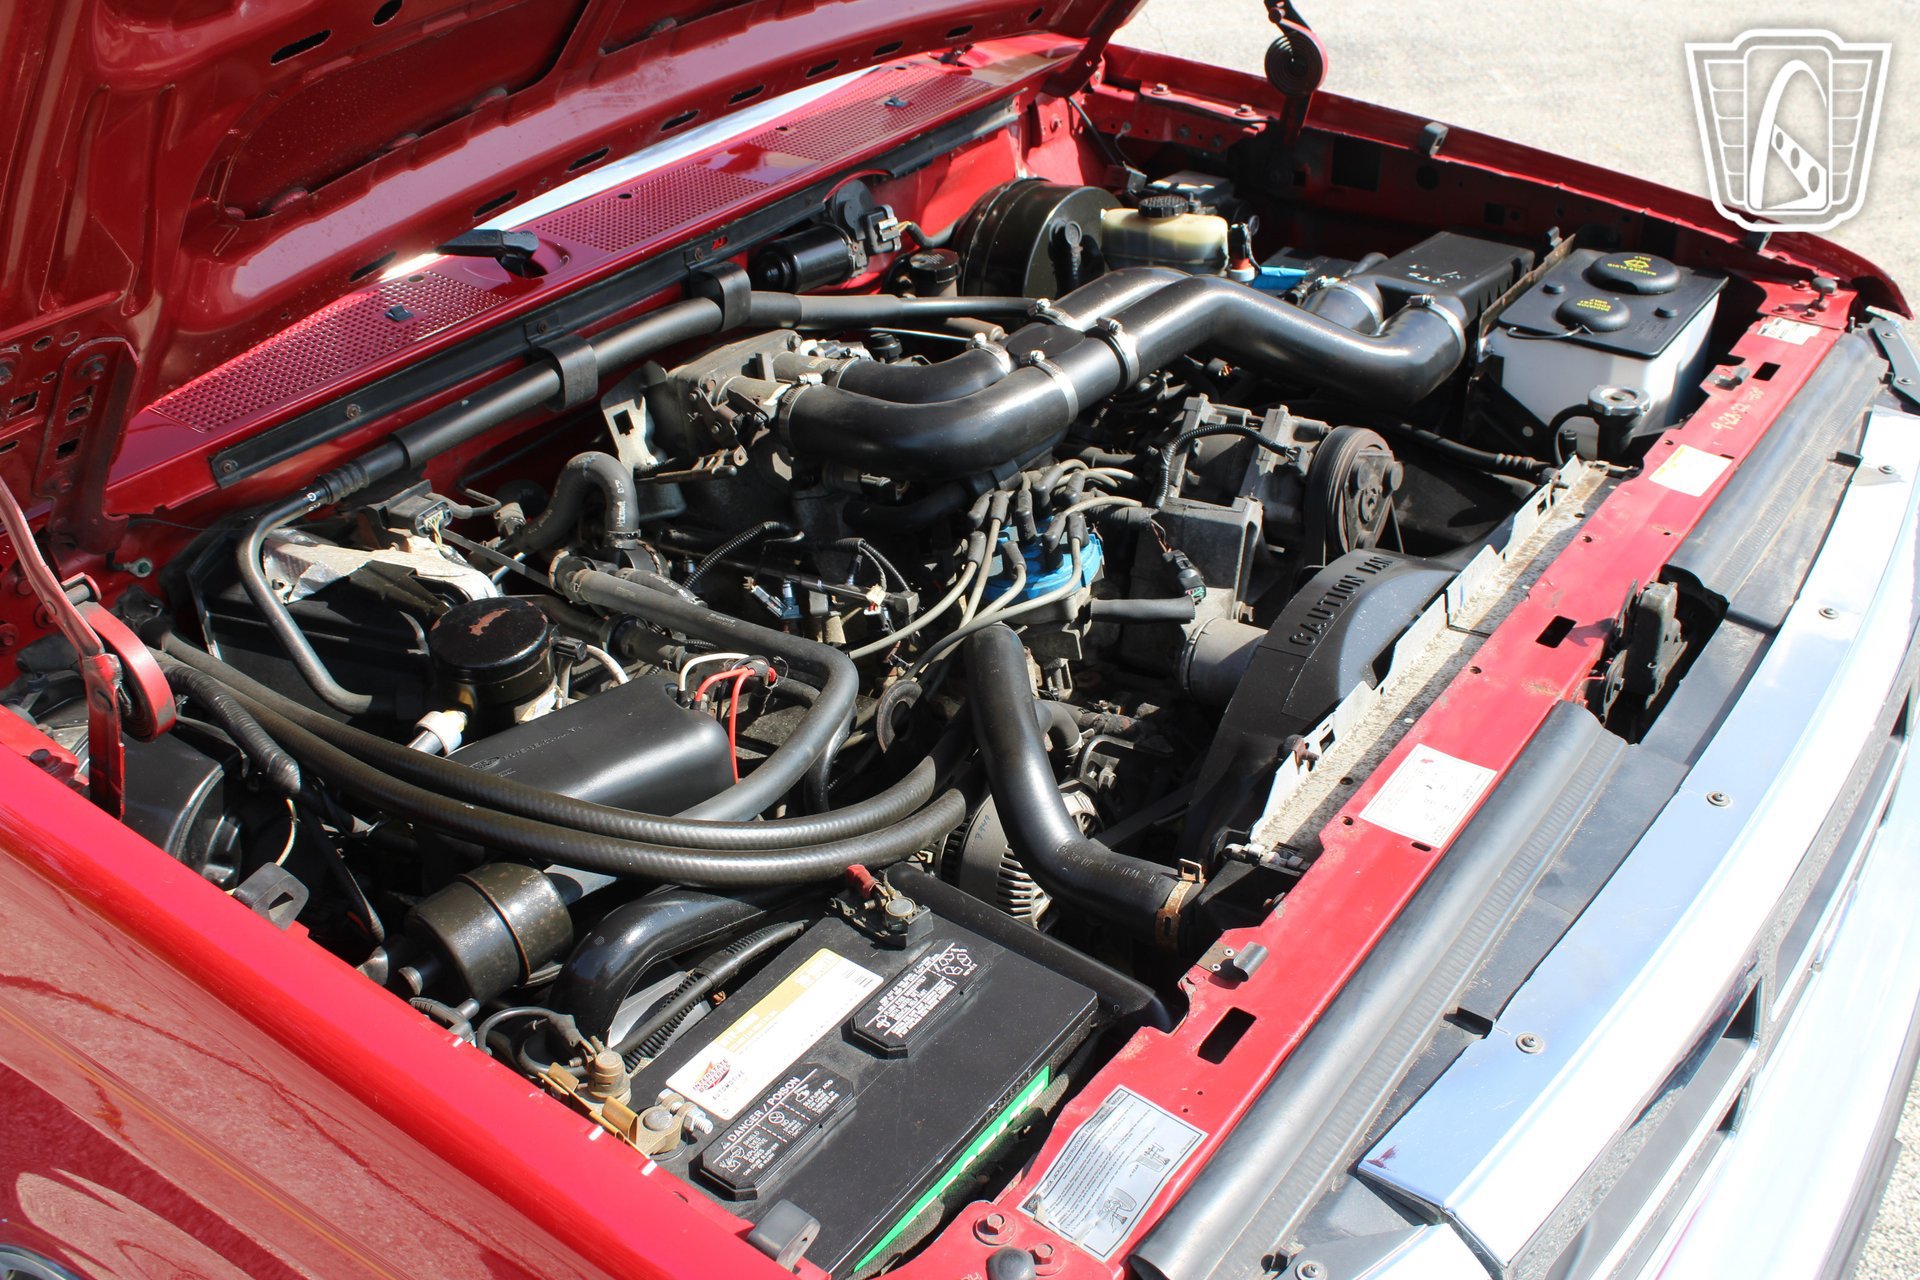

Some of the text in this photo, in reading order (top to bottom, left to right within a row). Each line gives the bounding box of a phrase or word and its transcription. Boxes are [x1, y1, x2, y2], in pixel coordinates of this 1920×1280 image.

[1289, 556, 1393, 646] CAUTION FAN
[693, 1059, 729, 1091] INTERSTATE
[699, 1064, 731, 1093] BATTERIES
[712, 1070, 745, 1101] AUTOMOTIVE
[803, 1079, 834, 1107] SULFURIC ACID
[727, 1109, 764, 1142] DANGER
[767, 1076, 801, 1106] POISON
[780, 1119, 790, 1127] NO
[743, 1130, 760, 1146] SHIELD
[743, 1138, 768, 1160] EXPLOSIVE
[748, 1137, 761, 1149] EYES
[747, 1148, 765, 1164] GASES
[1053, 1161, 1067, 1182] JACKING
[1064, 1131, 1086, 1163] INSTRUCTIONS
